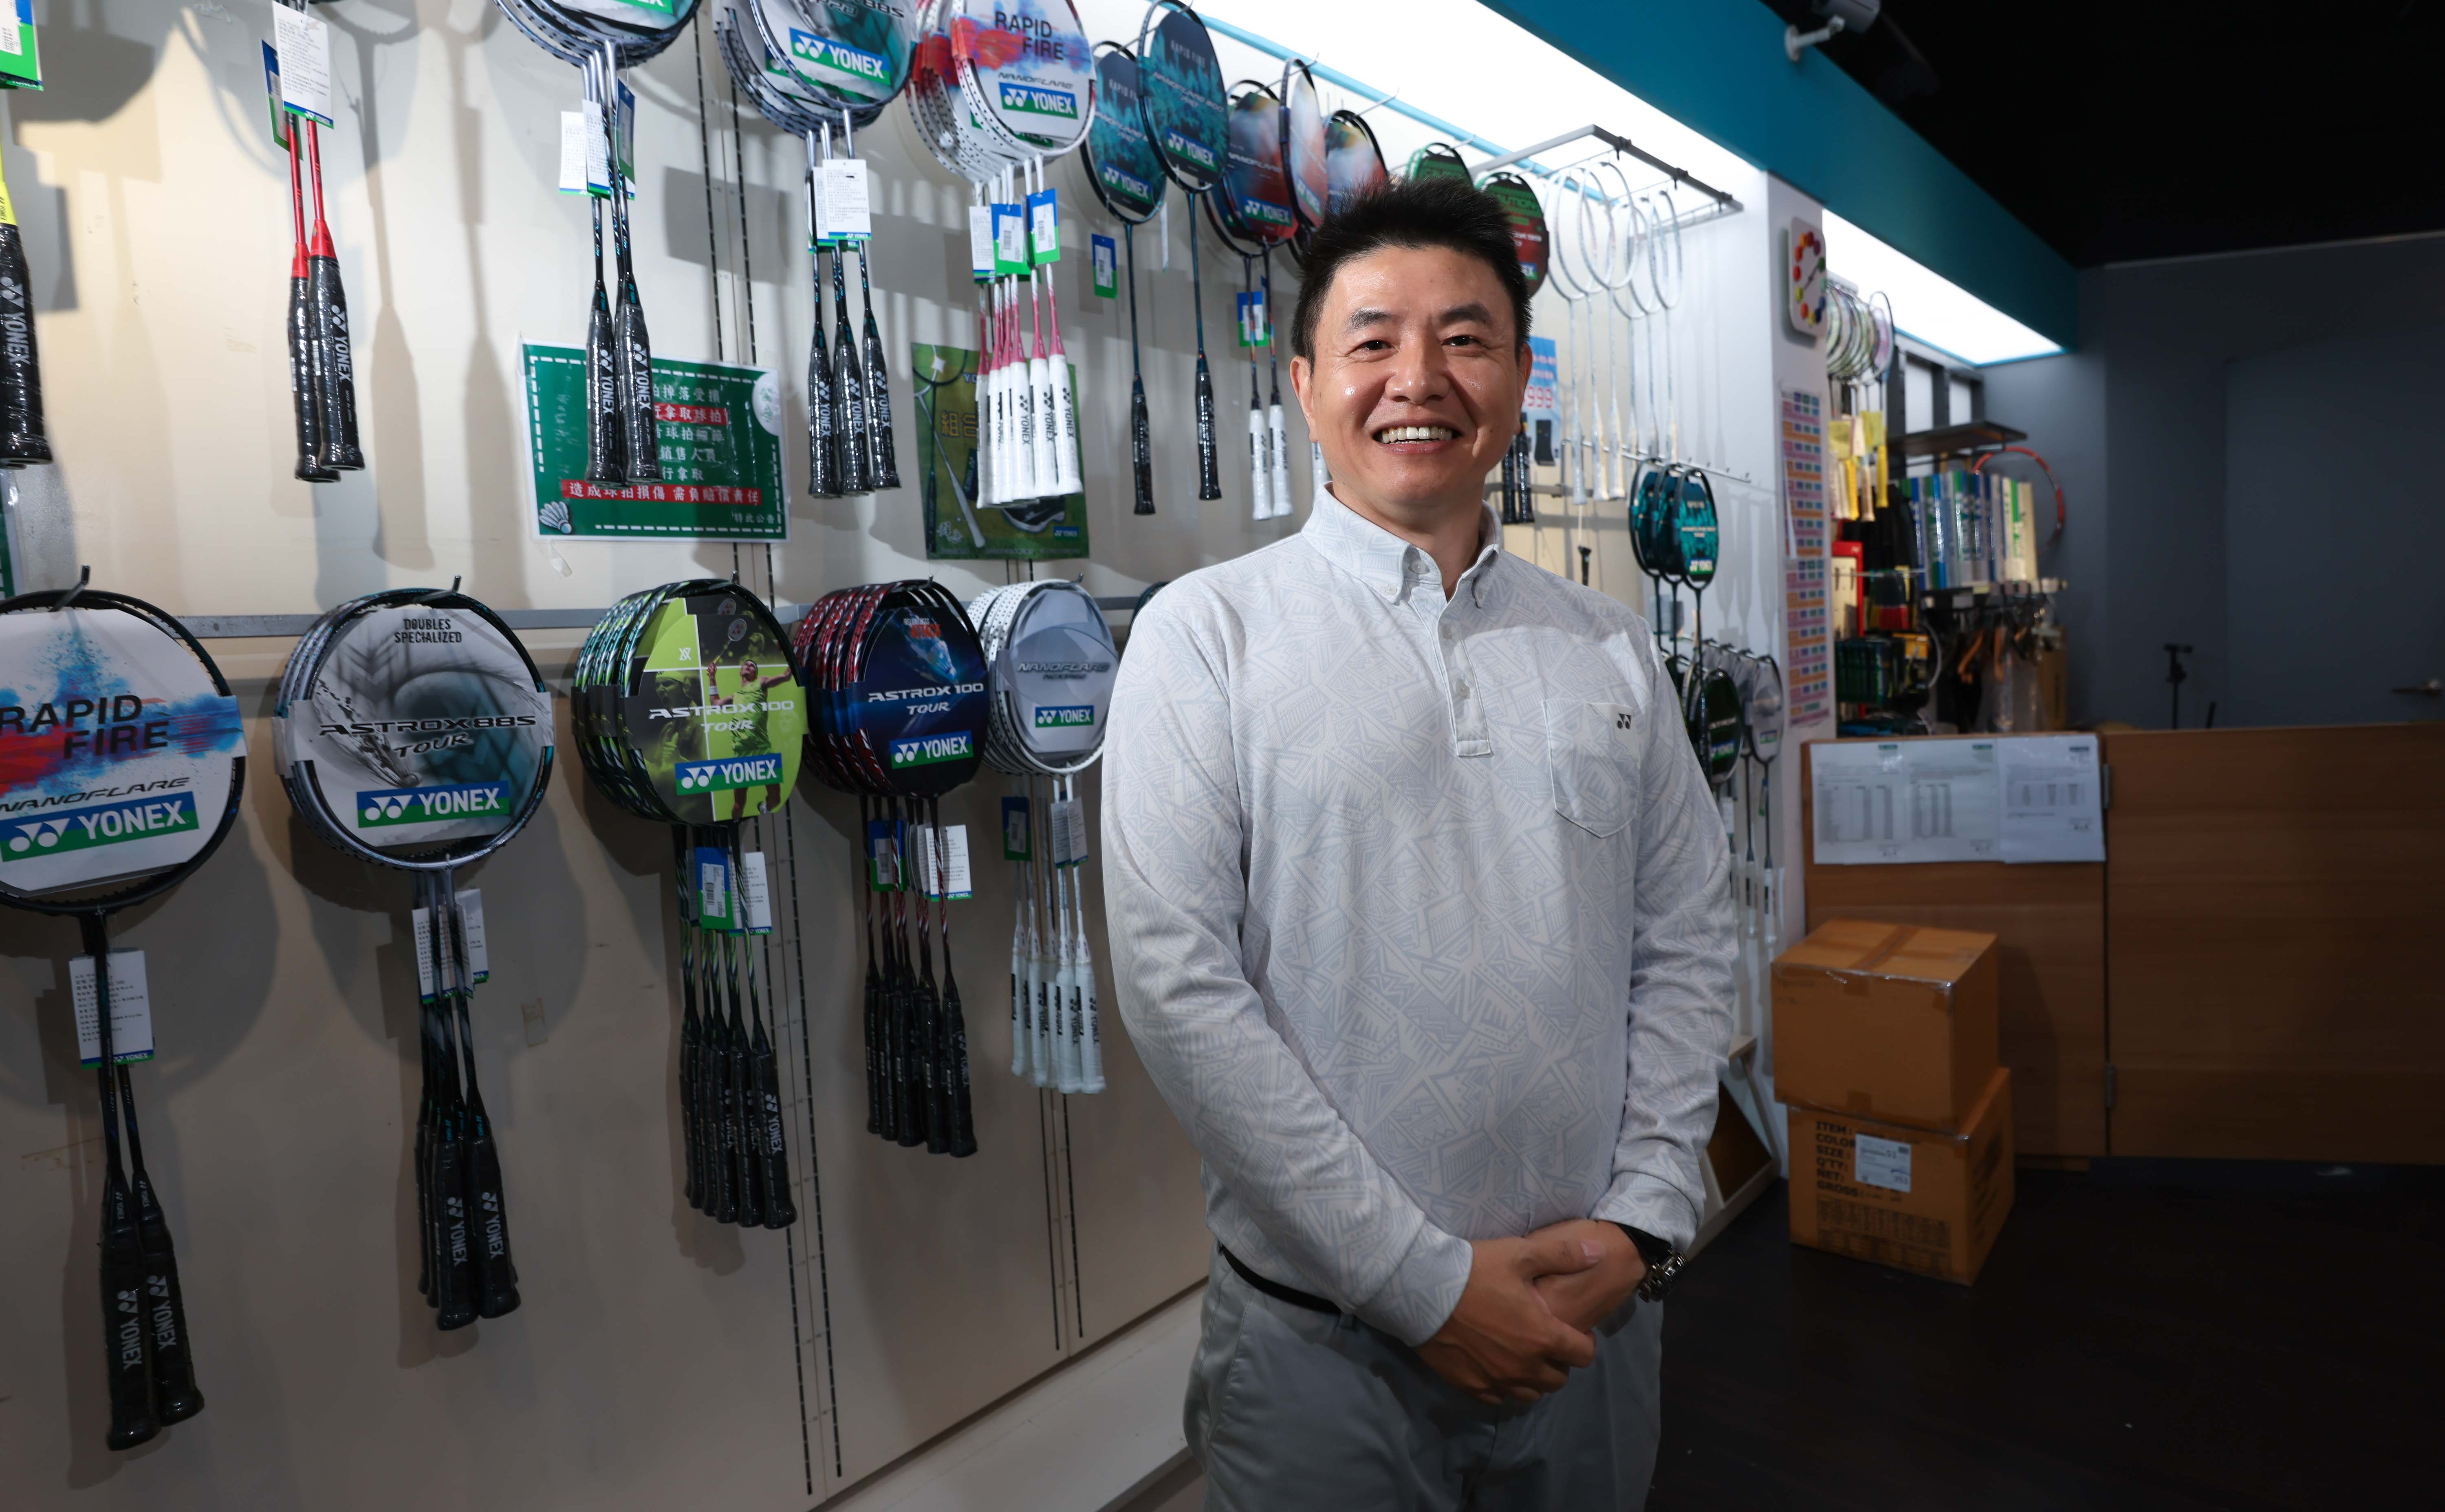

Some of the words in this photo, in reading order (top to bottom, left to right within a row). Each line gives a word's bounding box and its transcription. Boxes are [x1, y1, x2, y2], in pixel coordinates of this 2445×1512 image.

[995, 11, 1052, 38] RAPID
[828, 45, 884, 79] YONEX
[1022, 38, 1064, 60] FIRE
[998, 72, 1074, 89] NANOFLARE
[1030, 91, 1074, 114] YONEX
[1185, 139, 1214, 168] YONEX
[1120, 174, 1149, 200] YONEX
[1262, 205, 1291, 224] YONEX
[3, 312, 31, 366] YONEX
[334, 336, 352, 383] YONEX
[601, 375, 615, 416] YONEX
[636, 370, 652, 411] YONEX
[1523, 385, 1553, 409] 999
[820, 403, 832, 438] YONEX
[851, 401, 865, 435] YONEX
[878, 394, 892, 429] YONEX
[1064, 408, 1075, 438] YONEX
[1021, 415, 1031, 445] YONEX
[1045, 412, 1055, 442] YONEX
[394, 631, 462, 643] SPECIALIZED
[403, 618, 452, 630] DOUBLES
[868, 686, 952, 703] ASTROX
[954, 682, 985, 694] 100
[0, 694, 142, 733] RAPID
[648, 702, 756, 720] ASTROX
[760, 700, 795, 712] 100
[906, 701, 952, 715] TOUR
[1058, 709, 1092, 723] YONEX
[63, 721, 169, 760] FIRE
[700, 719, 756, 734] TOUR
[393, 733, 474, 758] TOUR
[922, 735, 970, 759] YONEX
[720, 759, 779, 784] YONEX
[0, 777, 190, 812] NANOFLARE
[418, 786, 501, 816] YONEX
[77, 800, 188, 840] YONEX
[126, 1053, 149, 1062] YONEX
[768, 1114, 783, 1156] YONEX
[449, 1220, 469, 1268] YONEX
[485, 1214, 506, 1262] YONEX
[151, 1300, 177, 1352] YONEX
[119, 1317, 143, 1372] YONEX
